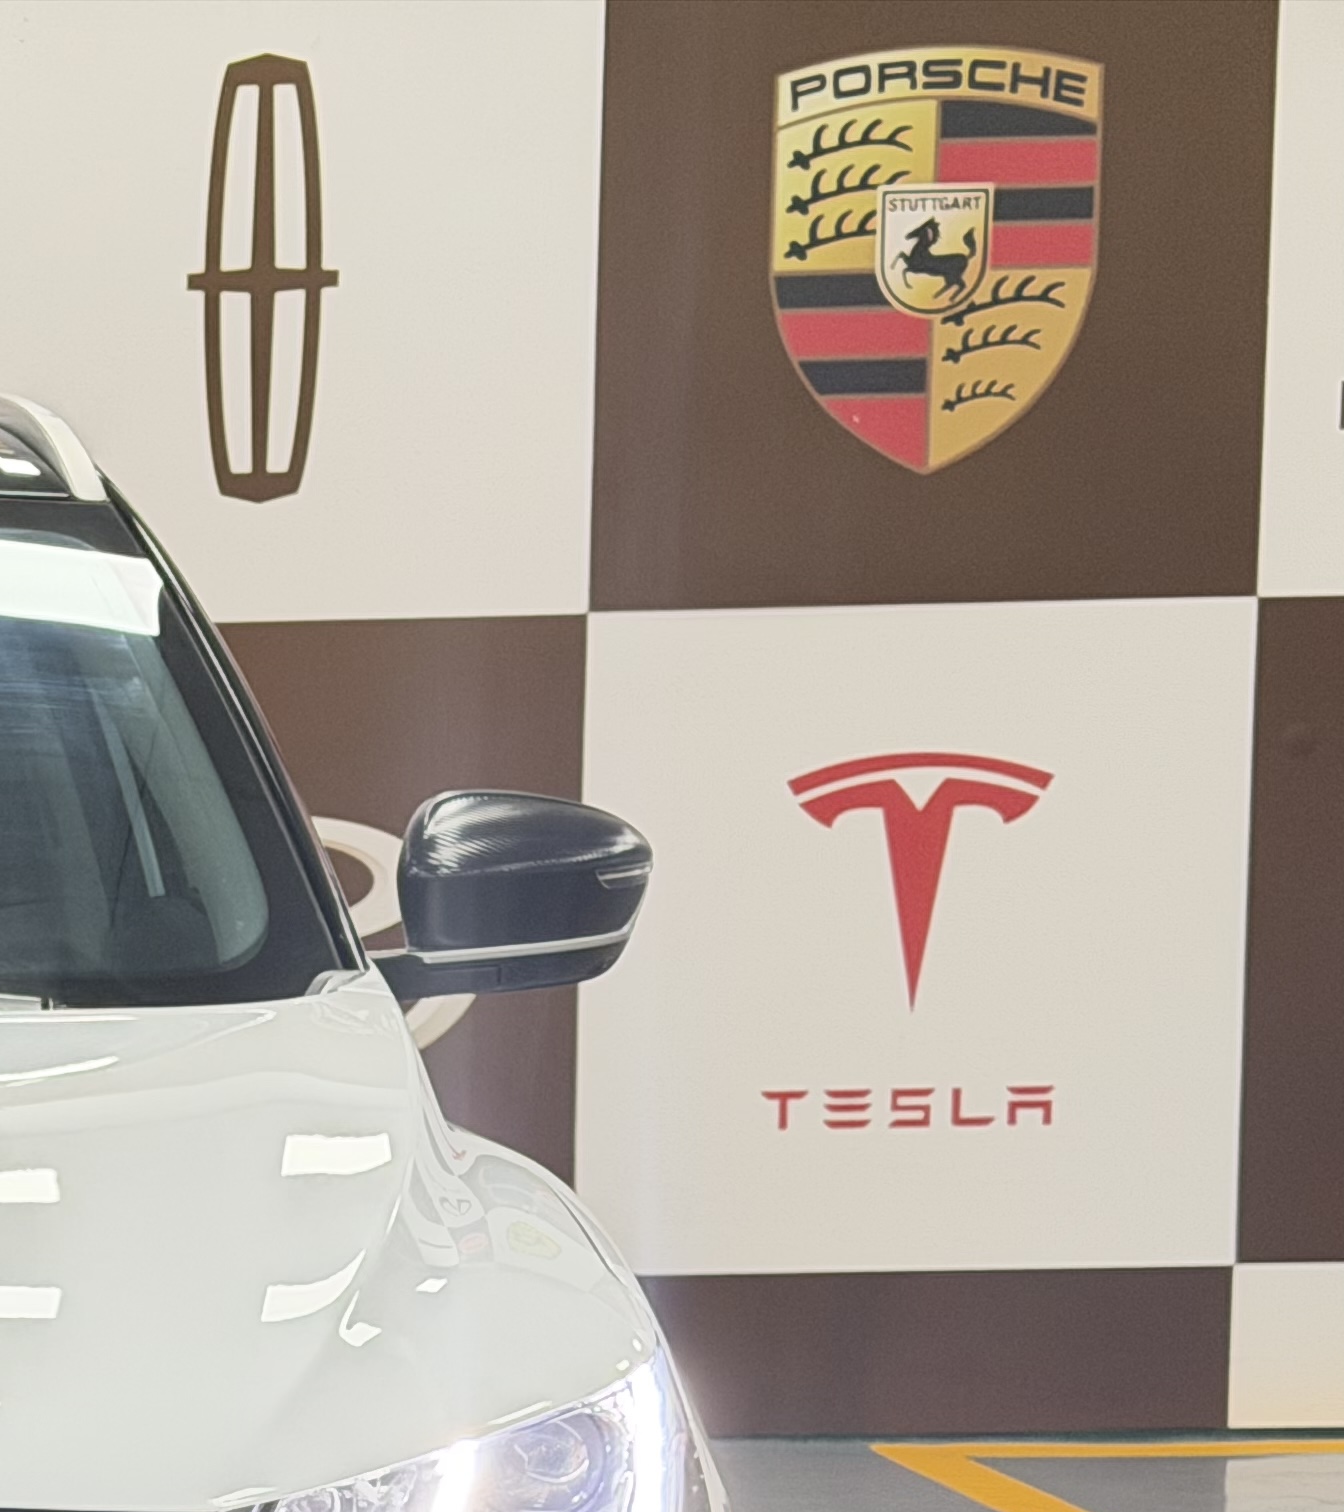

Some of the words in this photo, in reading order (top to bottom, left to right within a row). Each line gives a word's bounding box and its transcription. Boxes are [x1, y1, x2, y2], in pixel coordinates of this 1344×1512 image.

[790, 59, 1089, 112] PORSCHE
[887, 195, 982, 212] STUTTGART
[761, 1085, 1054, 1130] TESLA
